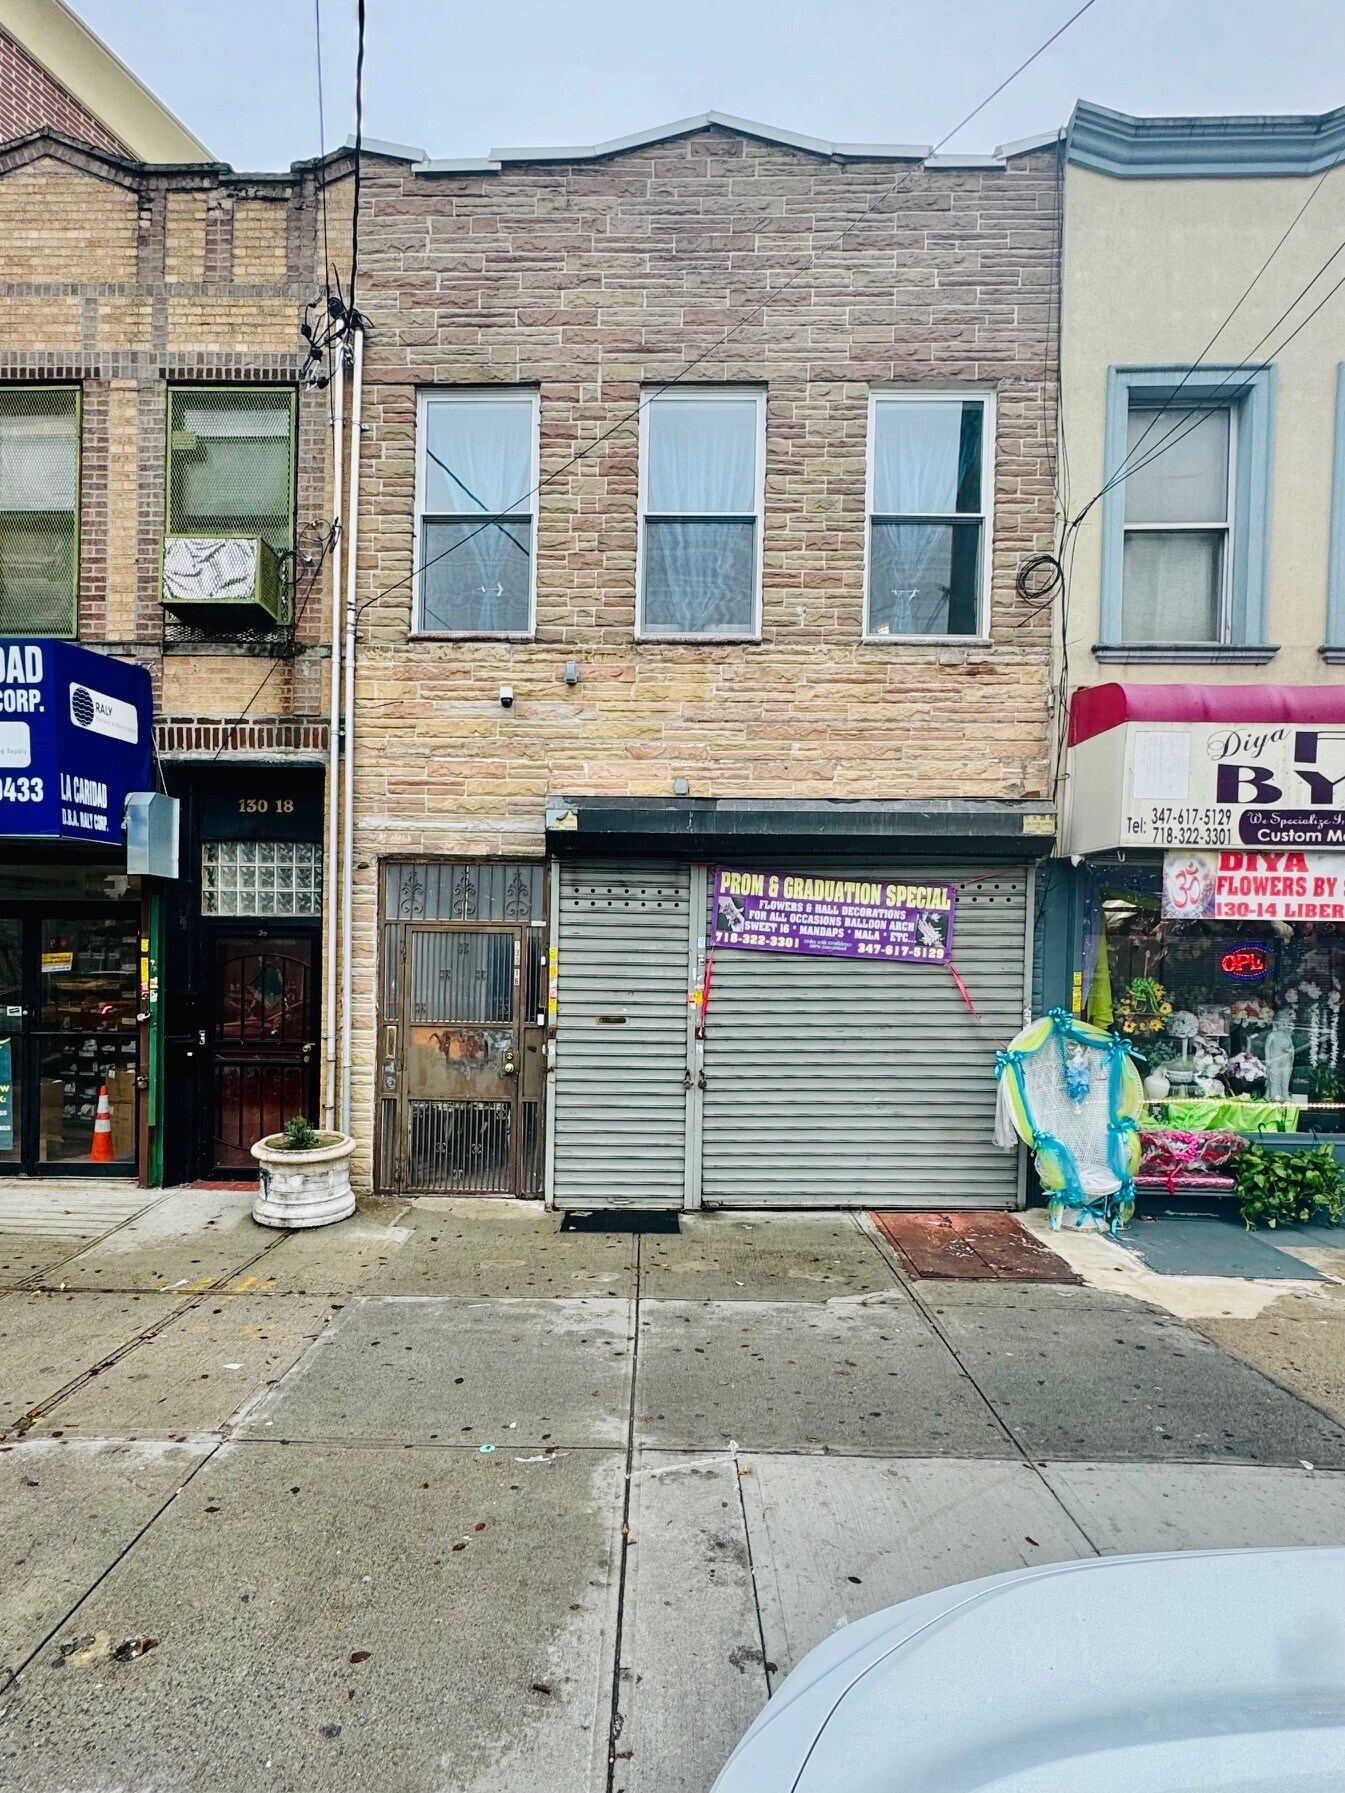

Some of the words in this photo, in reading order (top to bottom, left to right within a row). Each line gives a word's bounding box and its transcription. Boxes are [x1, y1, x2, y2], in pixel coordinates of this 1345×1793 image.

[0, 645, 43, 684] AD
[0, 689, 45, 713] ORP.
[96, 702, 113, 717] RALY
[1206, 728, 1291, 761] Diya
[0, 777, 43, 802] 433
[60, 772, 72, 801] LA
[74, 776, 108, 808] CARIDAD
[238, 799, 268, 812] 130
[276, 799, 294, 812] 18
[1127, 817, 1146, 834] Tel:
[1152, 808, 1232, 825] 347-617-5129
[1247, 812, 1268, 824] We
[1270, 812, 1331, 829] Specialize
[1332, 812, 1345, 825] I
[1153, 827, 1232, 844] 718-322-3301
[1258, 828, 1322, 842] Custom
[1219, 852, 1309, 872] DIYA
[720, 872, 764, 896] PROM
[768, 875, 779, 897] &
[784, 876, 882, 905] GRADUATION
[886, 884, 951, 910] SPECIAL
[1216, 876, 1306, 897] FLOWERS
[1313, 877, 1338, 897] BY
[759, 900, 803, 912] FLOWERS
[806, 904, 812, 912] &
[815, 904, 839, 914] HALL
[842, 906, 906, 920] DECORATIONS
[1216, 902, 1277, 918] 130-14
[1285, 903, 1345, 918] LIBER
[744, 921, 777, 932] SWEET
[780, 924, 790, 933] 16
[799, 926, 844, 938] MANDAPS
[854, 930, 880, 940] MALA
[749, 910, 767, 920] FOR
[769, 912, 787, 922] ALL
[790, 914, 842, 926] OCCASIONS
[844, 918, 887, 930] BALLOON
[889, 922, 914, 932] ARCH
[716, 932, 800, 948] 718-322-3301
[858, 943, 944, 958] 347-617-5129
